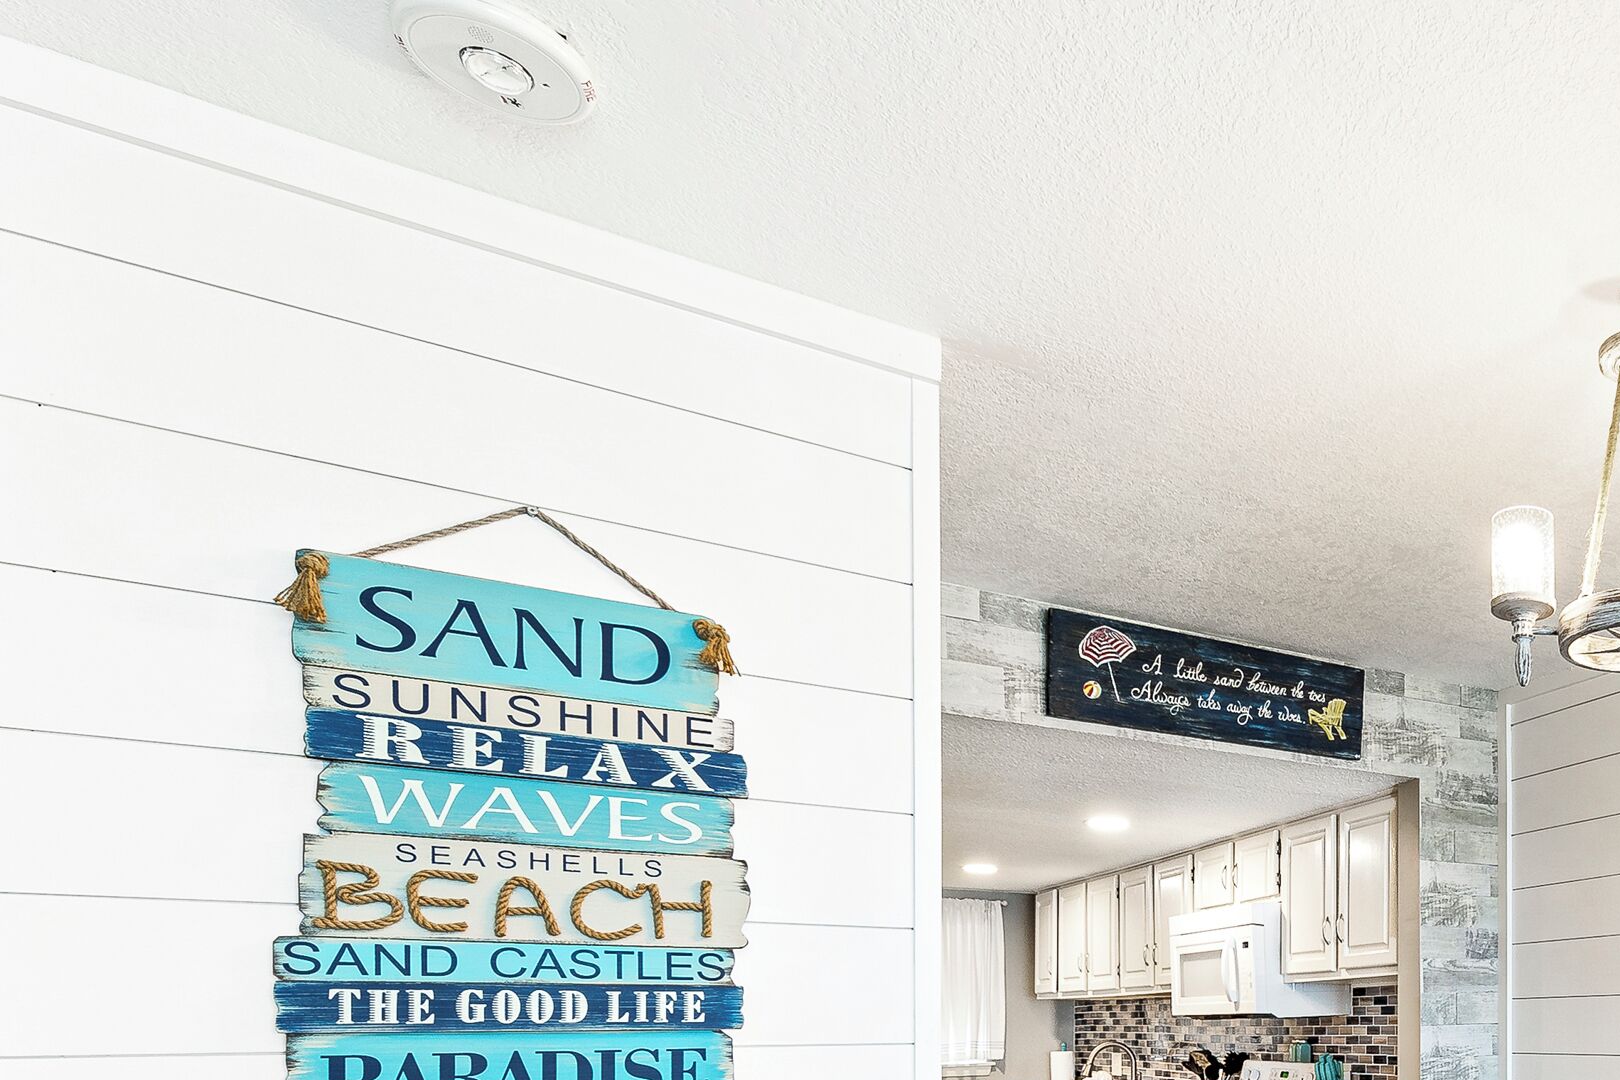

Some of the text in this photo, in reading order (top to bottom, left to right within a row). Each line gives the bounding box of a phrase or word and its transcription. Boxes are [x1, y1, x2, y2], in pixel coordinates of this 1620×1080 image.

[355, 585, 671, 685] SAND
[1130, 680, 1191, 715] Always
[1197, 688, 1221, 710] takes
[1226, 700, 1253, 725] away
[1257, 700, 1273, 719] the
[1142, 654, 1326, 703] A little sand between the toes
[332, 673, 715, 748] SUNSHINE
[355, 714, 716, 792] RELAX
[357, 774, 704, 844] WAVES
[395, 843, 663, 877] SEASHELLS
[311, 859, 712, 940] BEACH
[282, 940, 727, 981] SAND CASTLES
[327, 988, 706, 1025] THE GOOD LIFE
